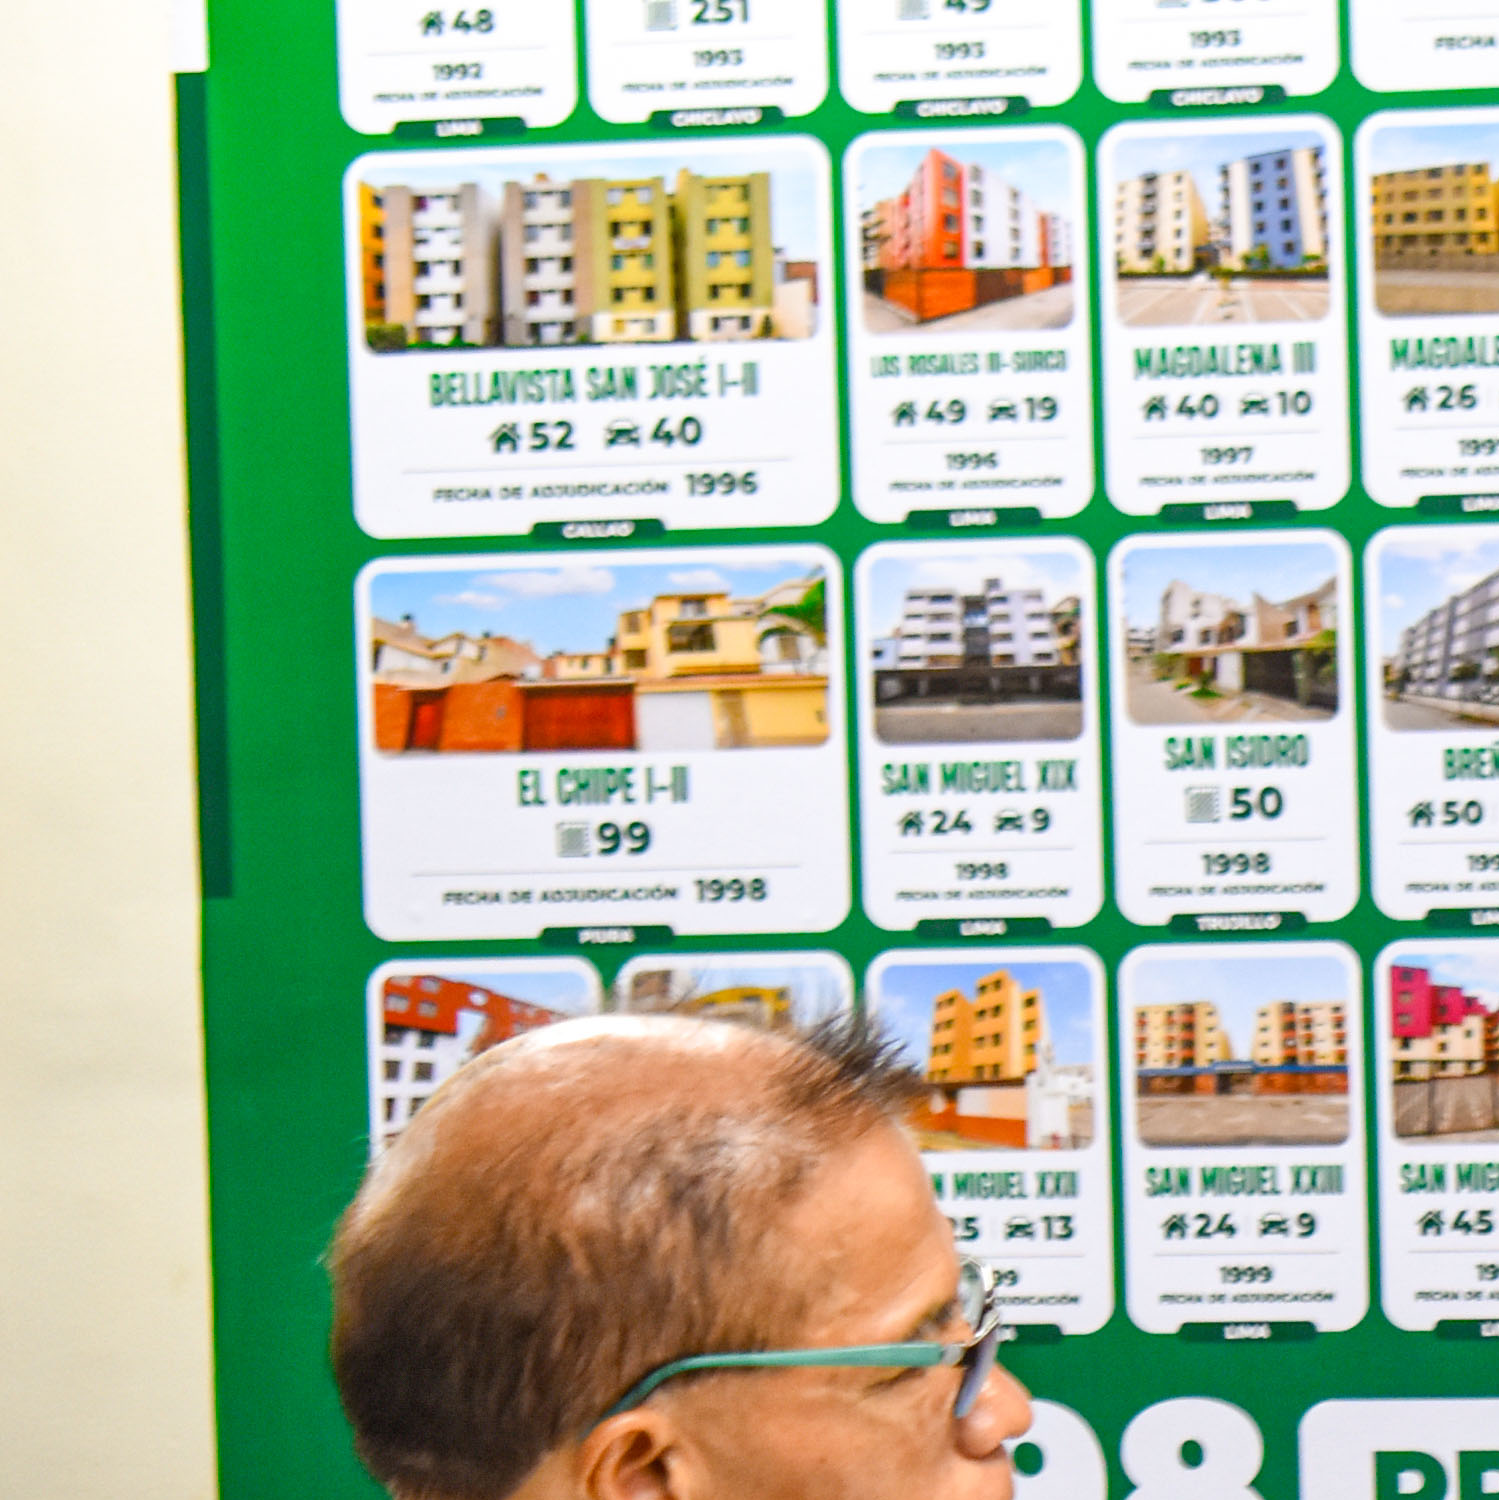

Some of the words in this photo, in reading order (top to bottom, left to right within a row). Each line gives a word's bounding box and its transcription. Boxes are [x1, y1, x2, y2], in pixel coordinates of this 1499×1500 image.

[452, 9, 495, 34] 48
[1435, 36, 1497, 50] FECHA
[1134, 344, 1283, 378] MAGDALENA
[1293, 341, 1317, 374] III
[430, 368, 576, 408] BELLAVISTA
[587, 367, 638, 402] SAN
[648, 361, 709, 400] JOSÉ
[925, 399, 967, 424] 49
[1025, 396, 1059, 421] 19
[531, 420, 575, 451] 52
[651, 416, 703, 447] 40
[433, 488, 493, 502] FECHA
[499, 485, 523, 500] DE
[530, 480, 671, 498] ADJUDICACIÓN
[686, 471, 758, 496] 1996
[1166, 737, 1216, 770] SAN
[1226, 734, 1310, 769] ISIDRO
[518, 769, 547, 807] EL
[557, 767, 636, 806] CHIPE
[883, 763, 930, 795] SAN
[940, 760, 1027, 794] MIGUEL
[1037, 760, 1077, 792] XIX
[598, 821, 651, 856] 99
[443, 891, 503, 905] FECHA
[509, 890, 533, 904] DE
[539, 885, 680, 903] ADJUDICACIÓN
[695, 878, 768, 902] 1998
[1402, 1163, 1446, 1193] SAN
